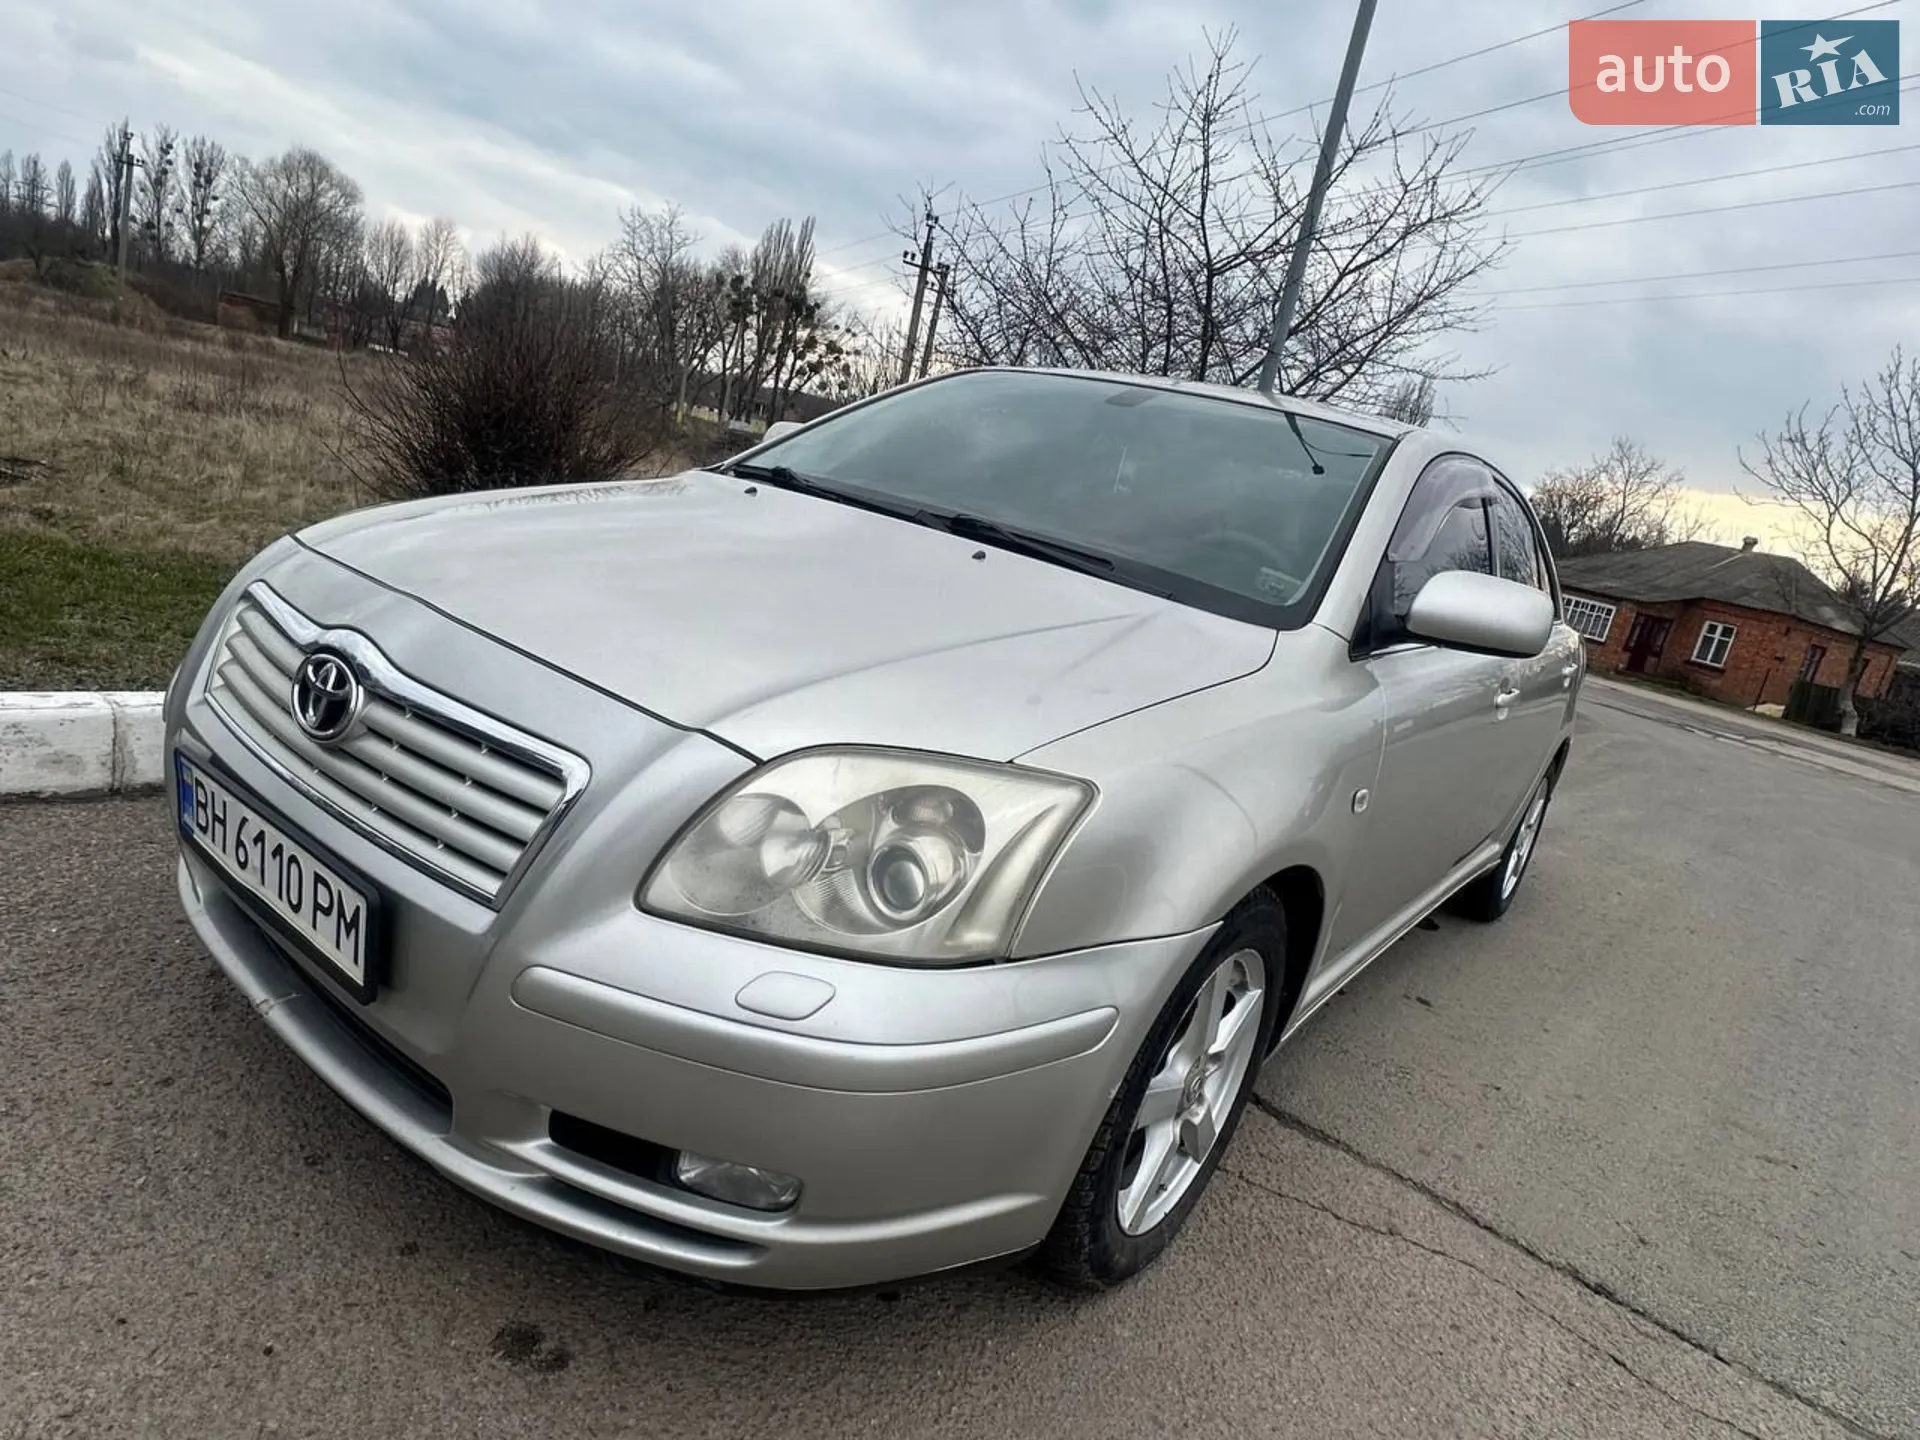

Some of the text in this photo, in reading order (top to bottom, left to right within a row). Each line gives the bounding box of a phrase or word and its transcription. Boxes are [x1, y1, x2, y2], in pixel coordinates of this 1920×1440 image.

[194, 776, 361, 967] BH 6110 PM
